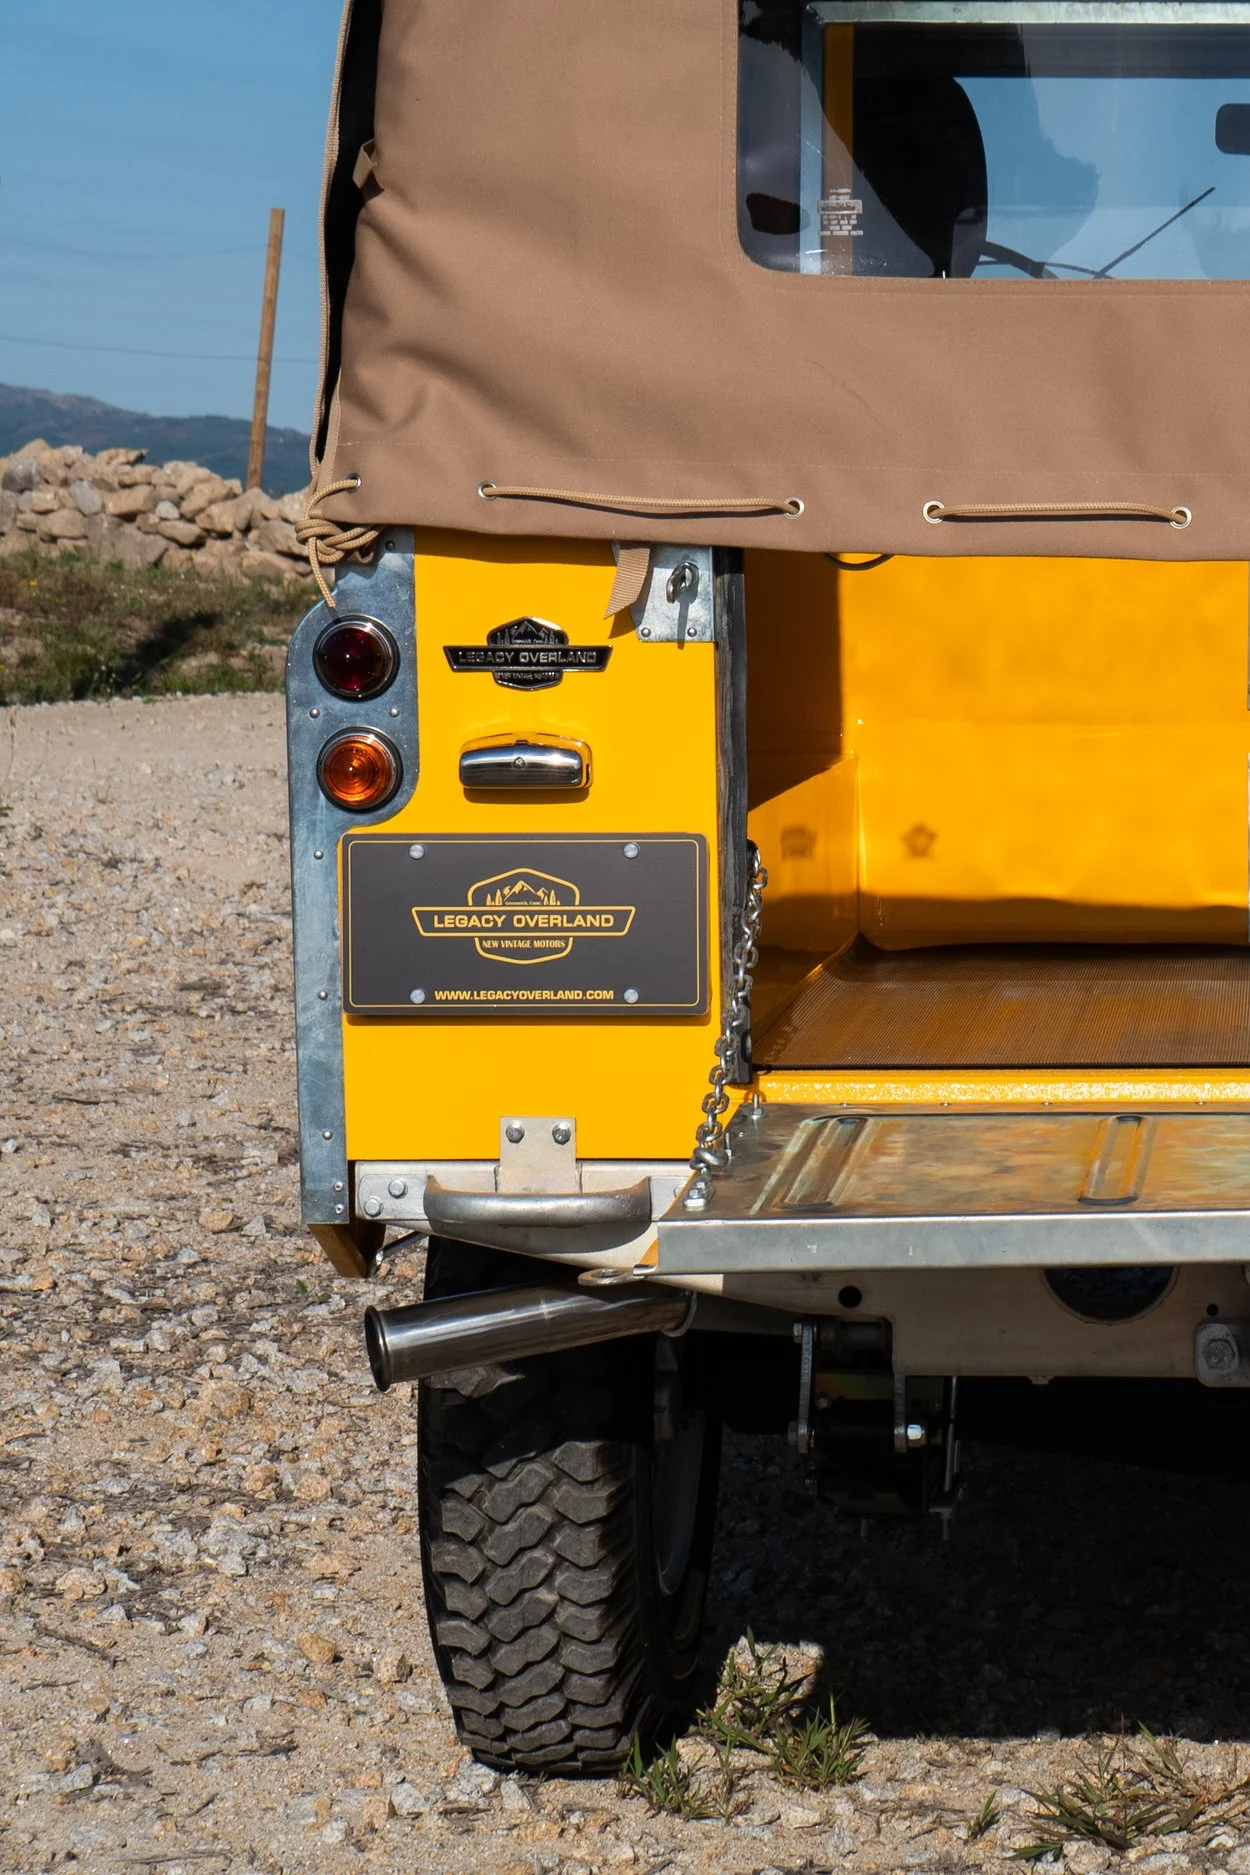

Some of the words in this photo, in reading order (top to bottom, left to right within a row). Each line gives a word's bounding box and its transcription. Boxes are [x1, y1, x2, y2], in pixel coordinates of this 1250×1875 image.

[459, 651, 514, 663] LEGACY
[519, 651, 597, 663] OVERLAND
[434, 914, 506, 928] LEGACY
[513, 914, 614, 928] OVERLAND
[482, 940, 499, 949] NEW
[500, 940, 532, 949] VINTAGE
[533, 940, 566, 949] MOTORS
[434, 990, 614, 1000] WWW.LEGACYOVERLAND.COM
